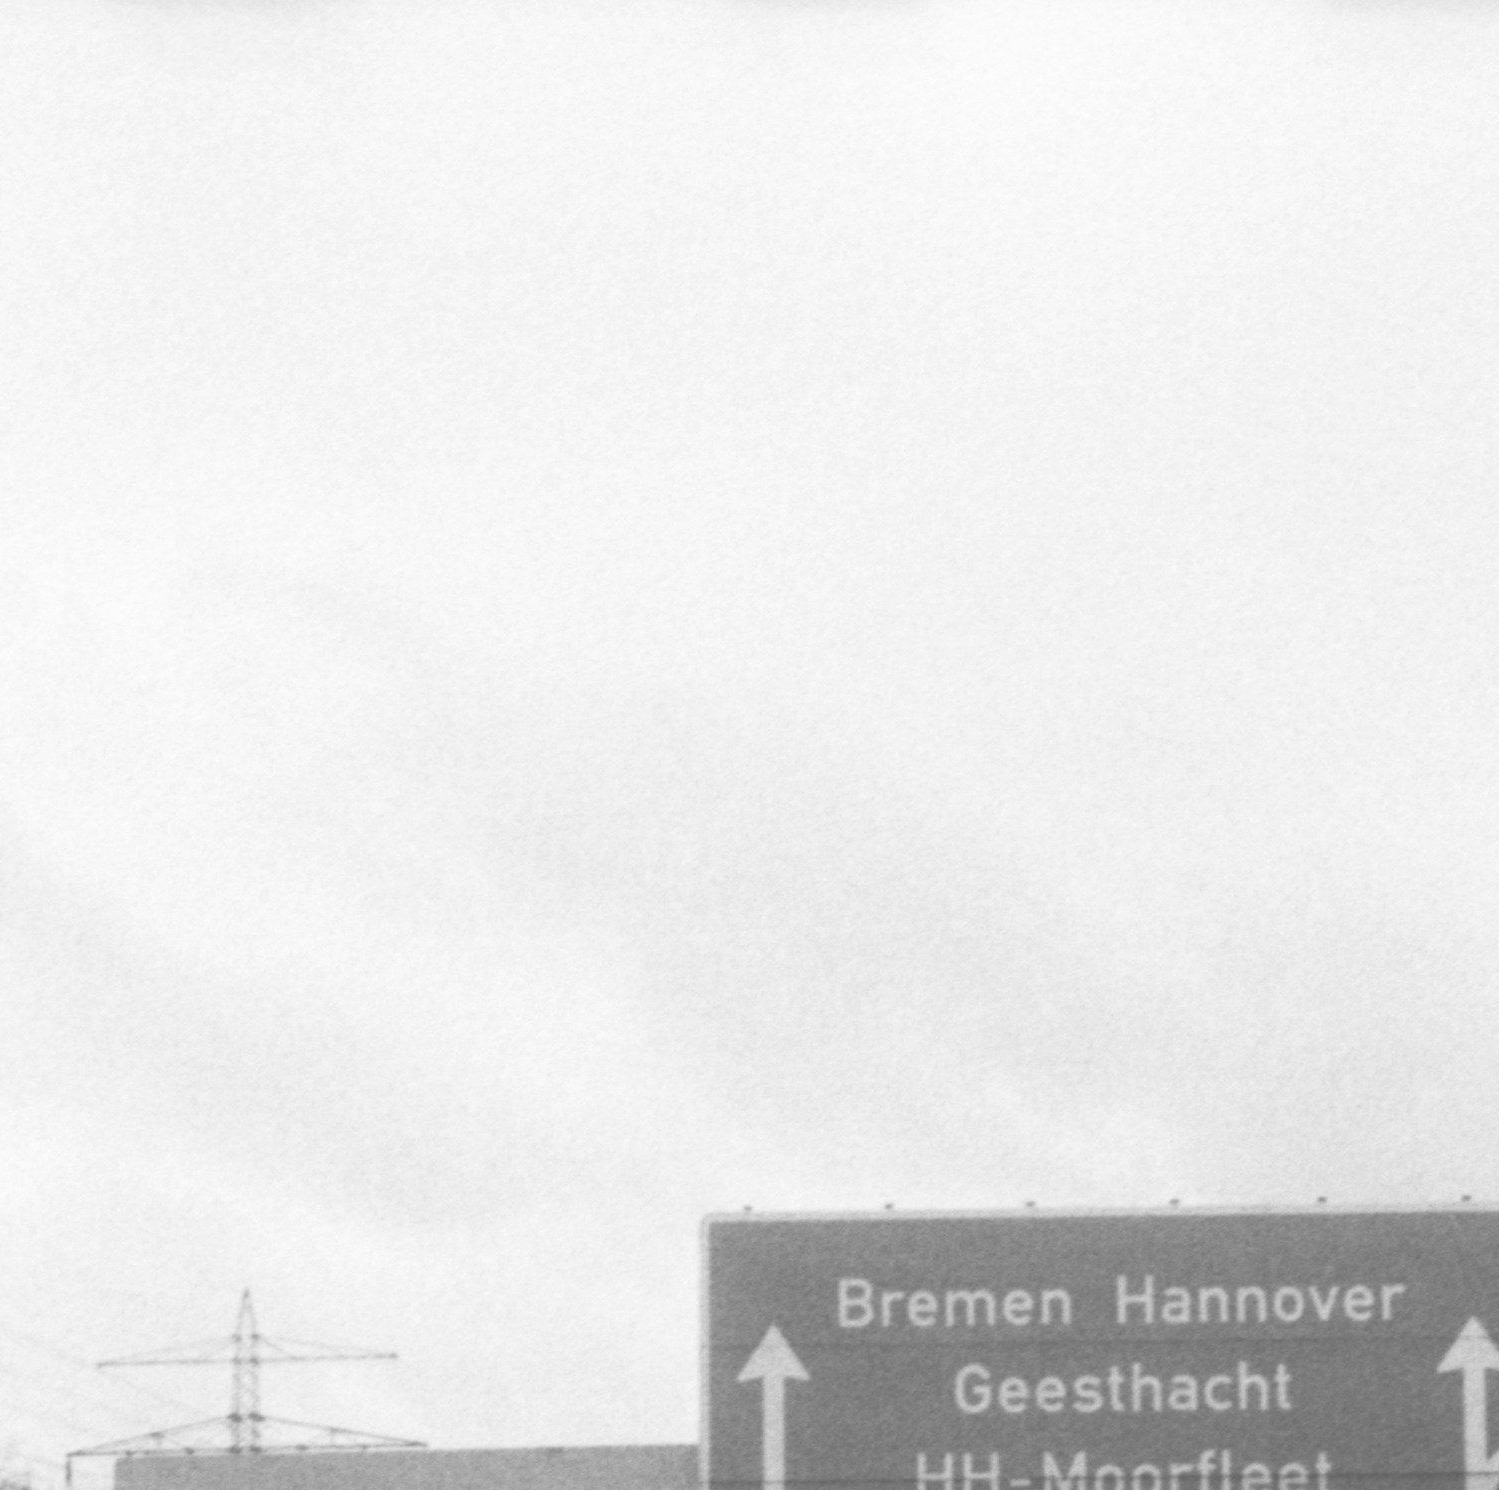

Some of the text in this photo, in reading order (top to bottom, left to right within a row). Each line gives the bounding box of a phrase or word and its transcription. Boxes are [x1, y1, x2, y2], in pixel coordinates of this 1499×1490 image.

[837, 1274, 1406, 1328] Bremen Hannover
[954, 1361, 1292, 1414] Geesthacht
